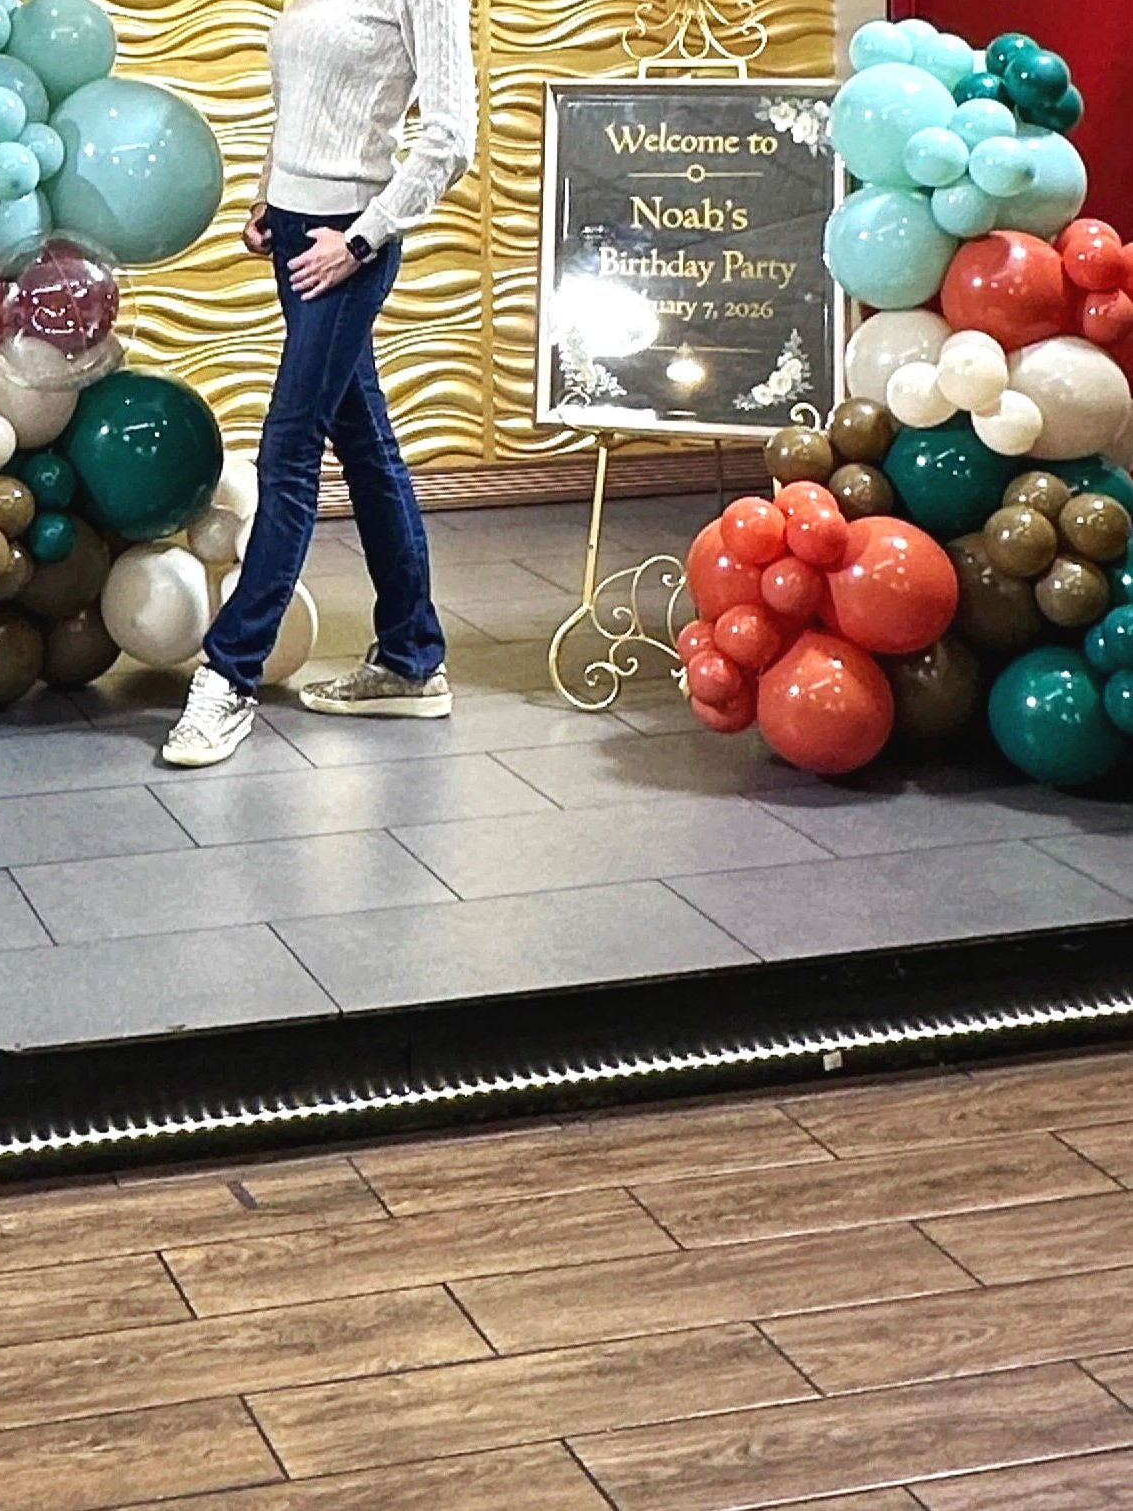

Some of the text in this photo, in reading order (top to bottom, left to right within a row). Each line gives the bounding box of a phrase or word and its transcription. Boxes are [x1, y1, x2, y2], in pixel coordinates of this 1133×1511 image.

[604, 122, 778, 155] Welcome to
[629, 196, 749, 232] Noah's
[598, 247, 797, 289] Birthday Party
[702, 301, 718, 320] 7,
[724, 300, 774, 320] 2026
